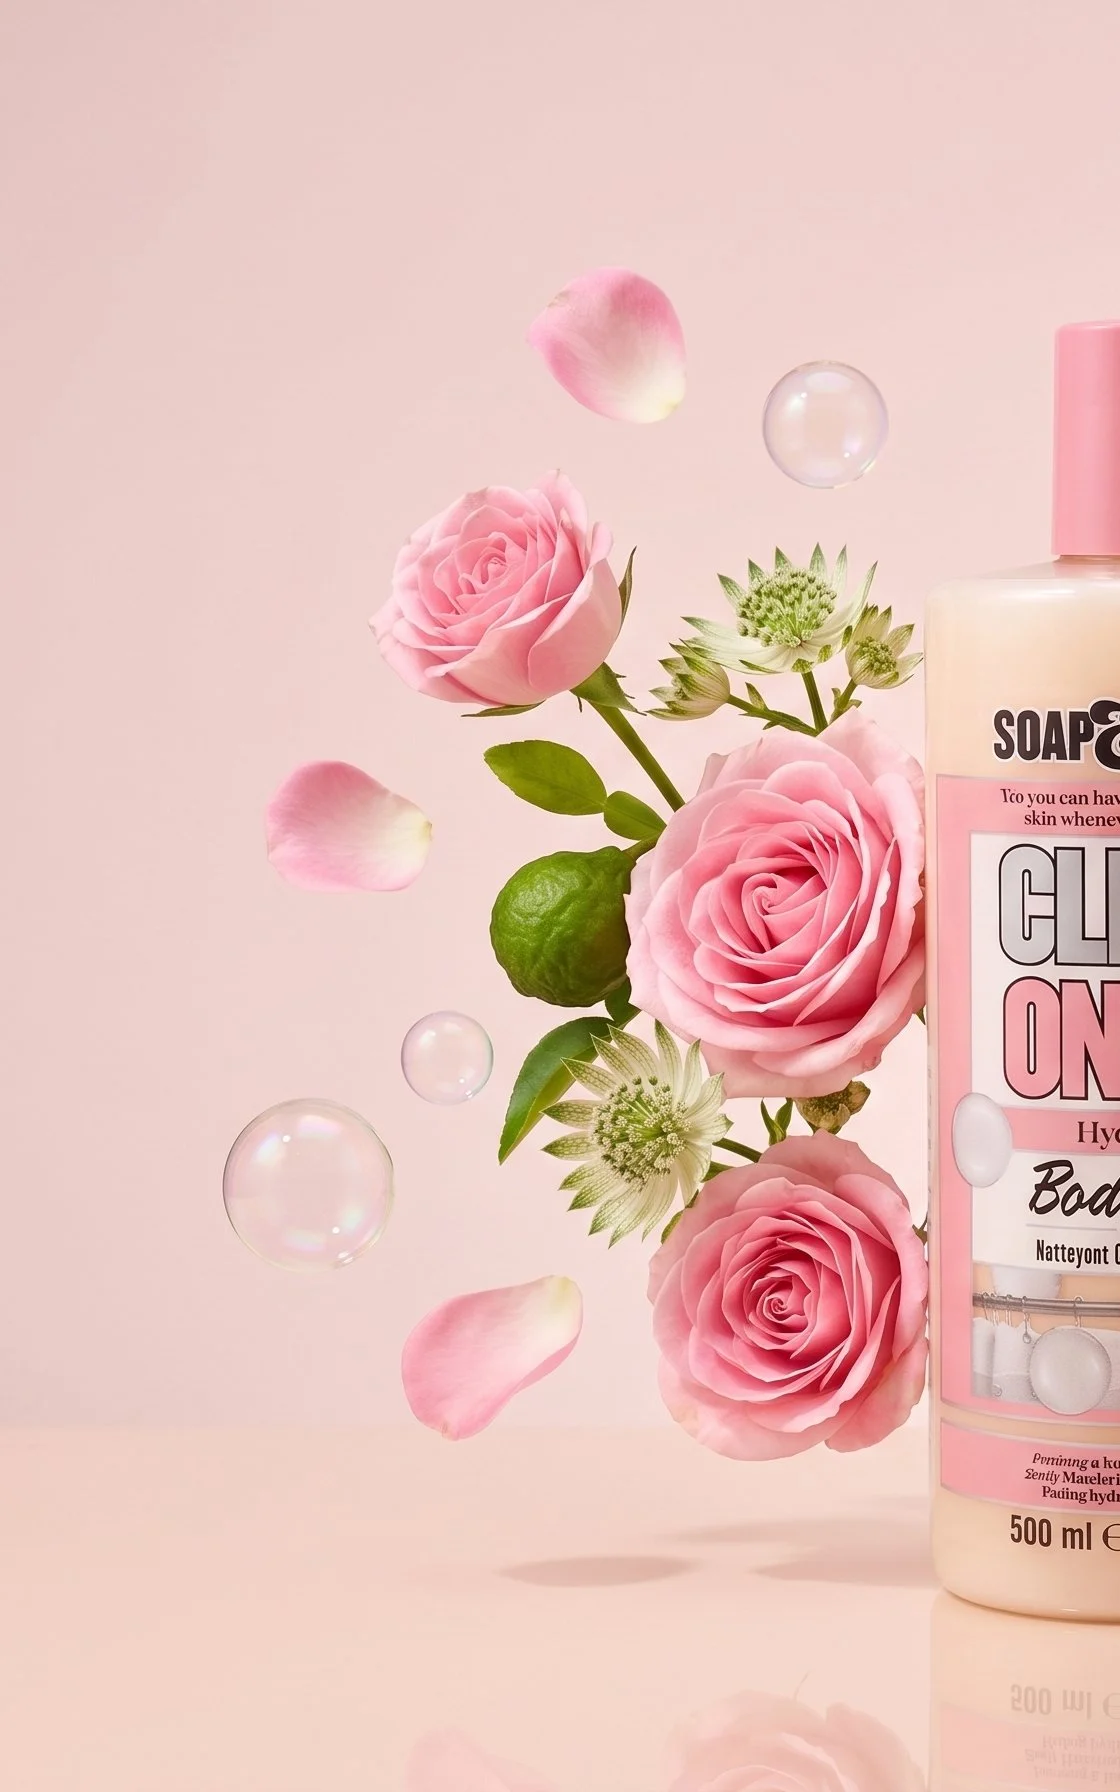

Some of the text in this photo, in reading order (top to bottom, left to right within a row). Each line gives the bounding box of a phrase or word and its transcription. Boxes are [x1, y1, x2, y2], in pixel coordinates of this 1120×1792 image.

[1027, 792, 1056, 808] you
[1059, 793, 1089, 805] can
[1024, 809, 1057, 826] skin
[1090, 1459, 1100, 1469] a
[1010, 1515, 1052, 1547] 500
[1062, 1522, 1092, 1551] ml
